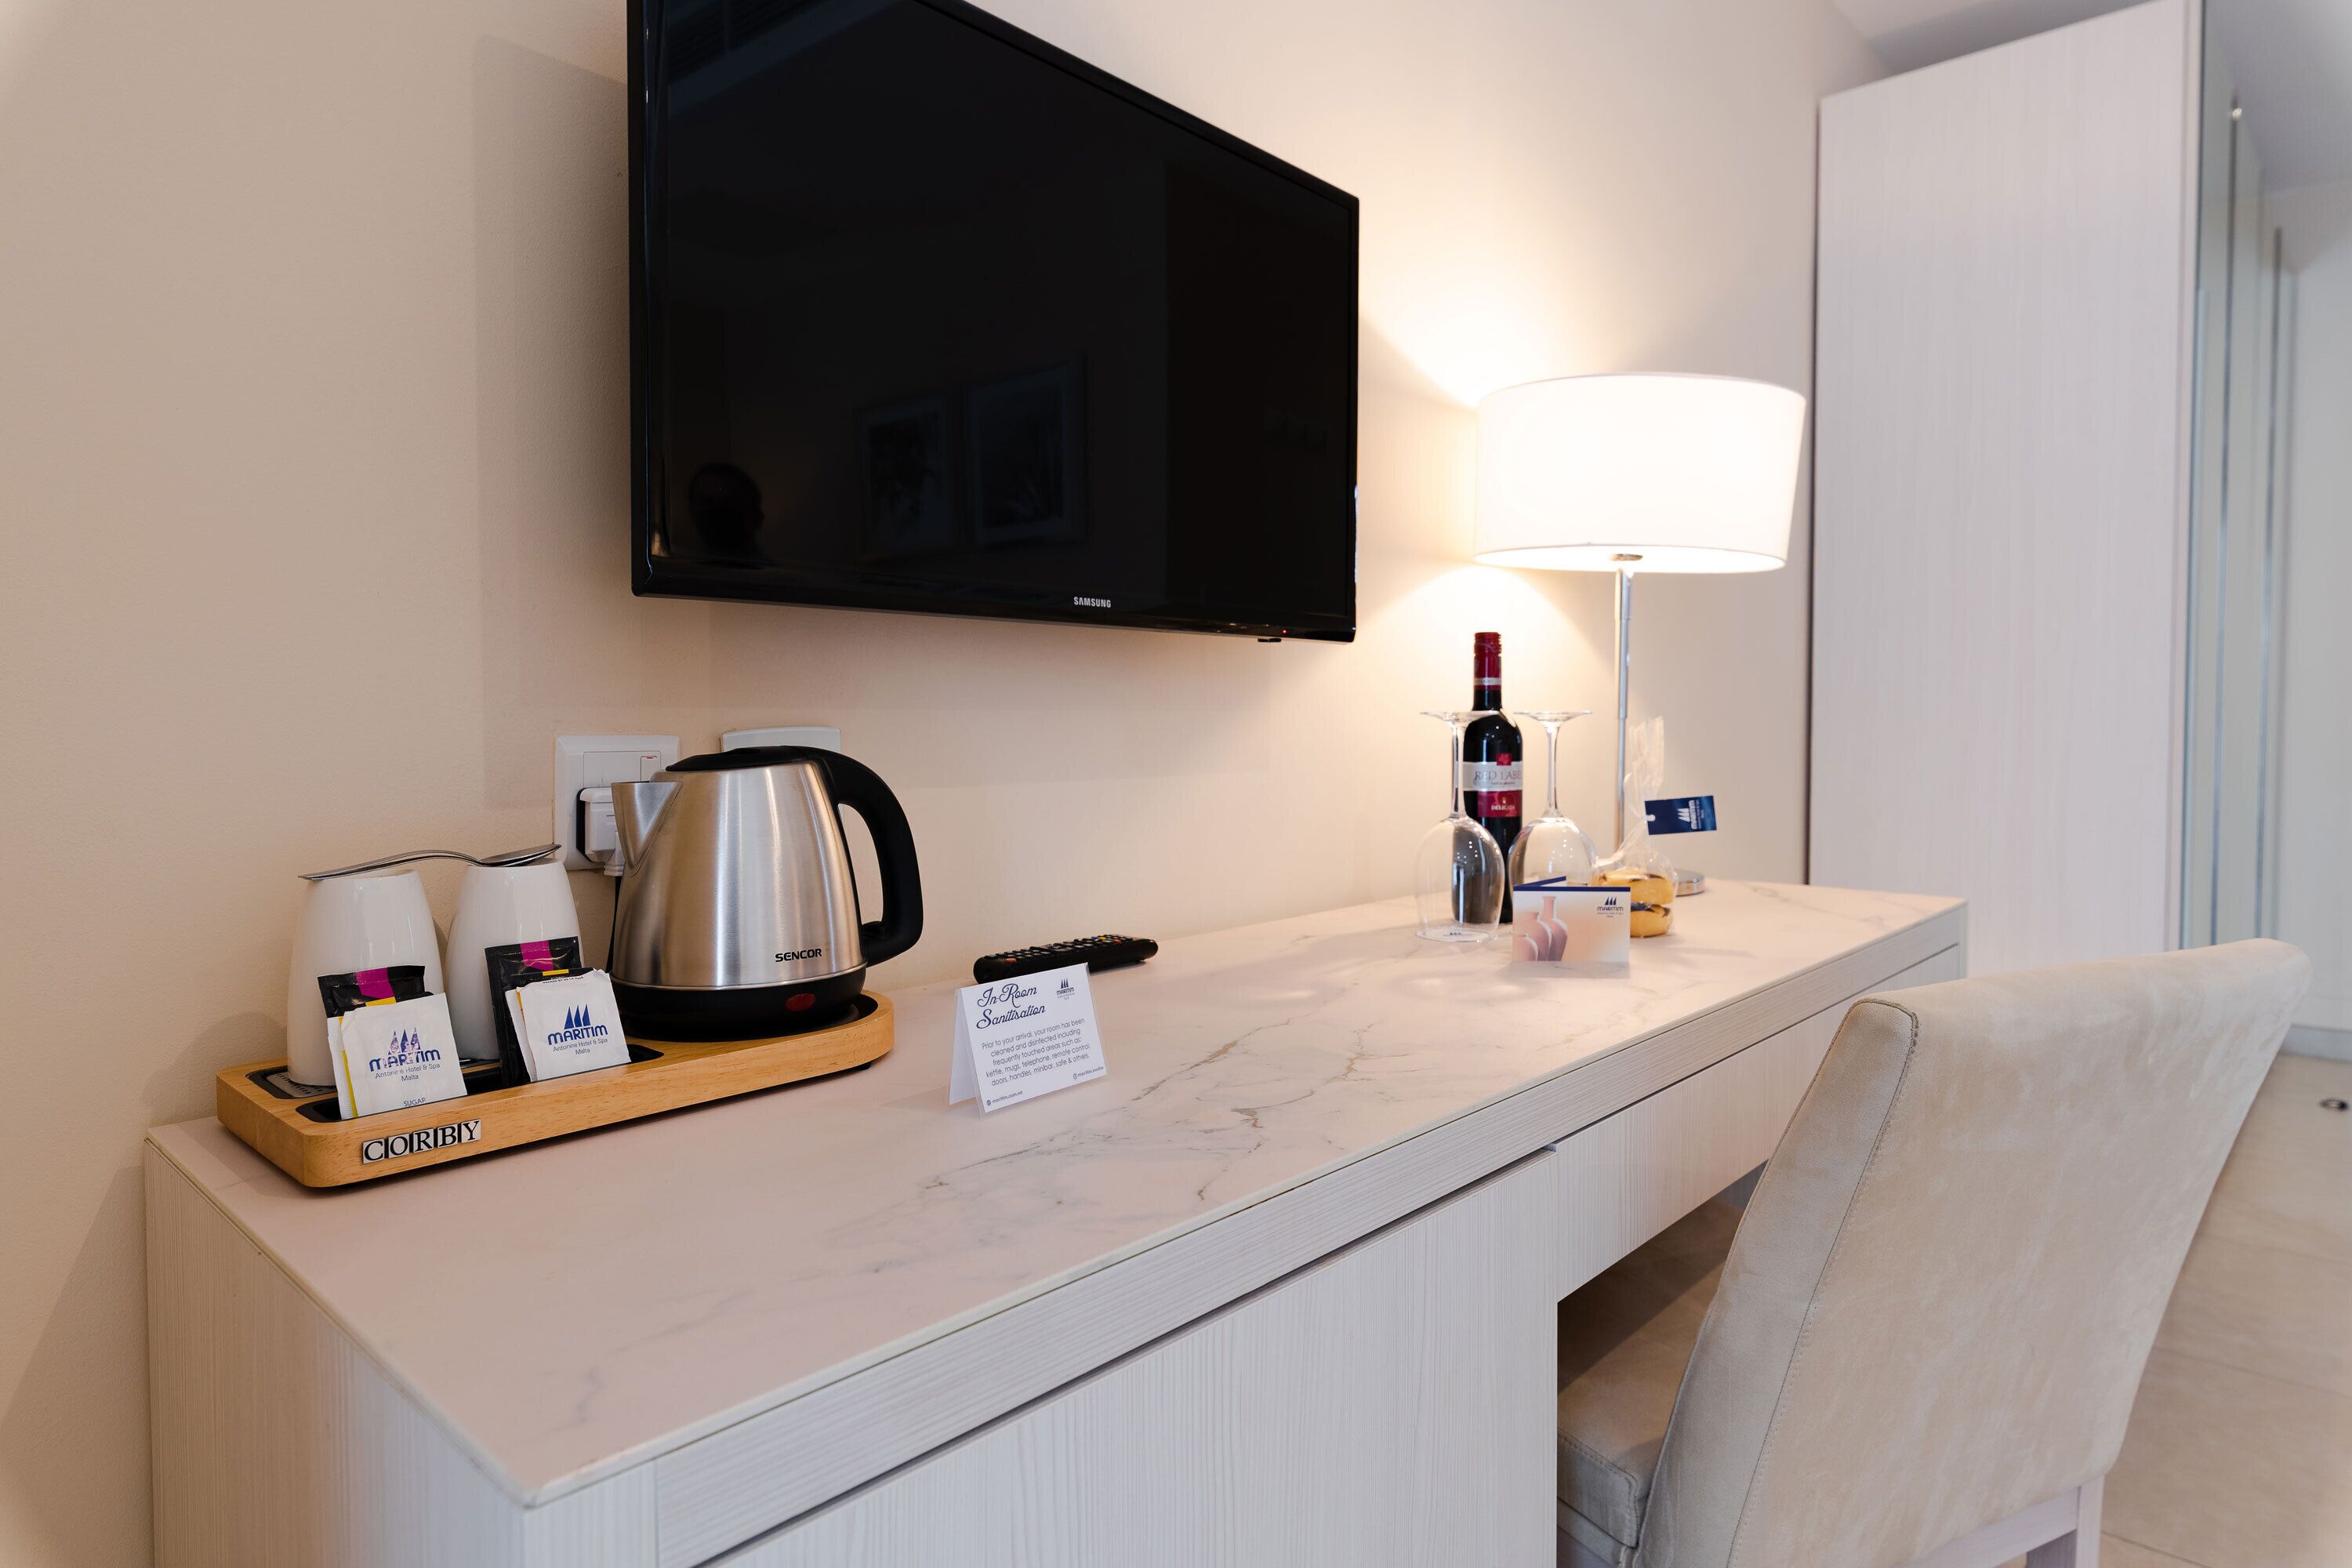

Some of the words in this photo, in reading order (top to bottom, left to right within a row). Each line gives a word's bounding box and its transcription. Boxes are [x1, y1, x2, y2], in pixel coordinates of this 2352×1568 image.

[1074, 597, 1112, 608] SAMSUNG
[1501, 771, 1521, 780] LABE
[775, 949, 822, 963] SENCOR
[977, 983, 1038, 1008] In-Room
[977, 1005, 1046, 1029] Sanitisation
[547, 1024, 608, 1046] MARITIM
[982, 1041, 994, 1050] Prior
[1002, 1036, 1014, 1045] your
[1033, 1029, 1046, 1038] your
[1046, 1024, 1060, 1034] room
[1061, 1020, 1071, 1030] has
[1071, 1018, 1085, 1027] been
[991, 1046, 1014, 1058] cleaned
[1014, 1041, 1027, 1051] and
[1027, 1034, 1057, 1048] disinfected
[1058, 1028, 1081, 1040] including
[554, 1041, 577, 1052] Antonine
[993, 1054, 1021, 1067] frequently
[1022, 1046, 1045, 1058] touched
[1046, 1043, 1061, 1052] areas
[1062, 1040, 1074, 1048] such
[1052, 1049, 1071, 1060] remote
[368, 1049, 441, 1071] MARITIM
[405, 1065, 422, 1076] Hotel
[428, 1062, 441, 1071] Spa
[1055, 1058, 1068, 1068] safe
[403, 1098, 426, 1107] SUGAR
[364, 1121, 480, 1160] CORBY
